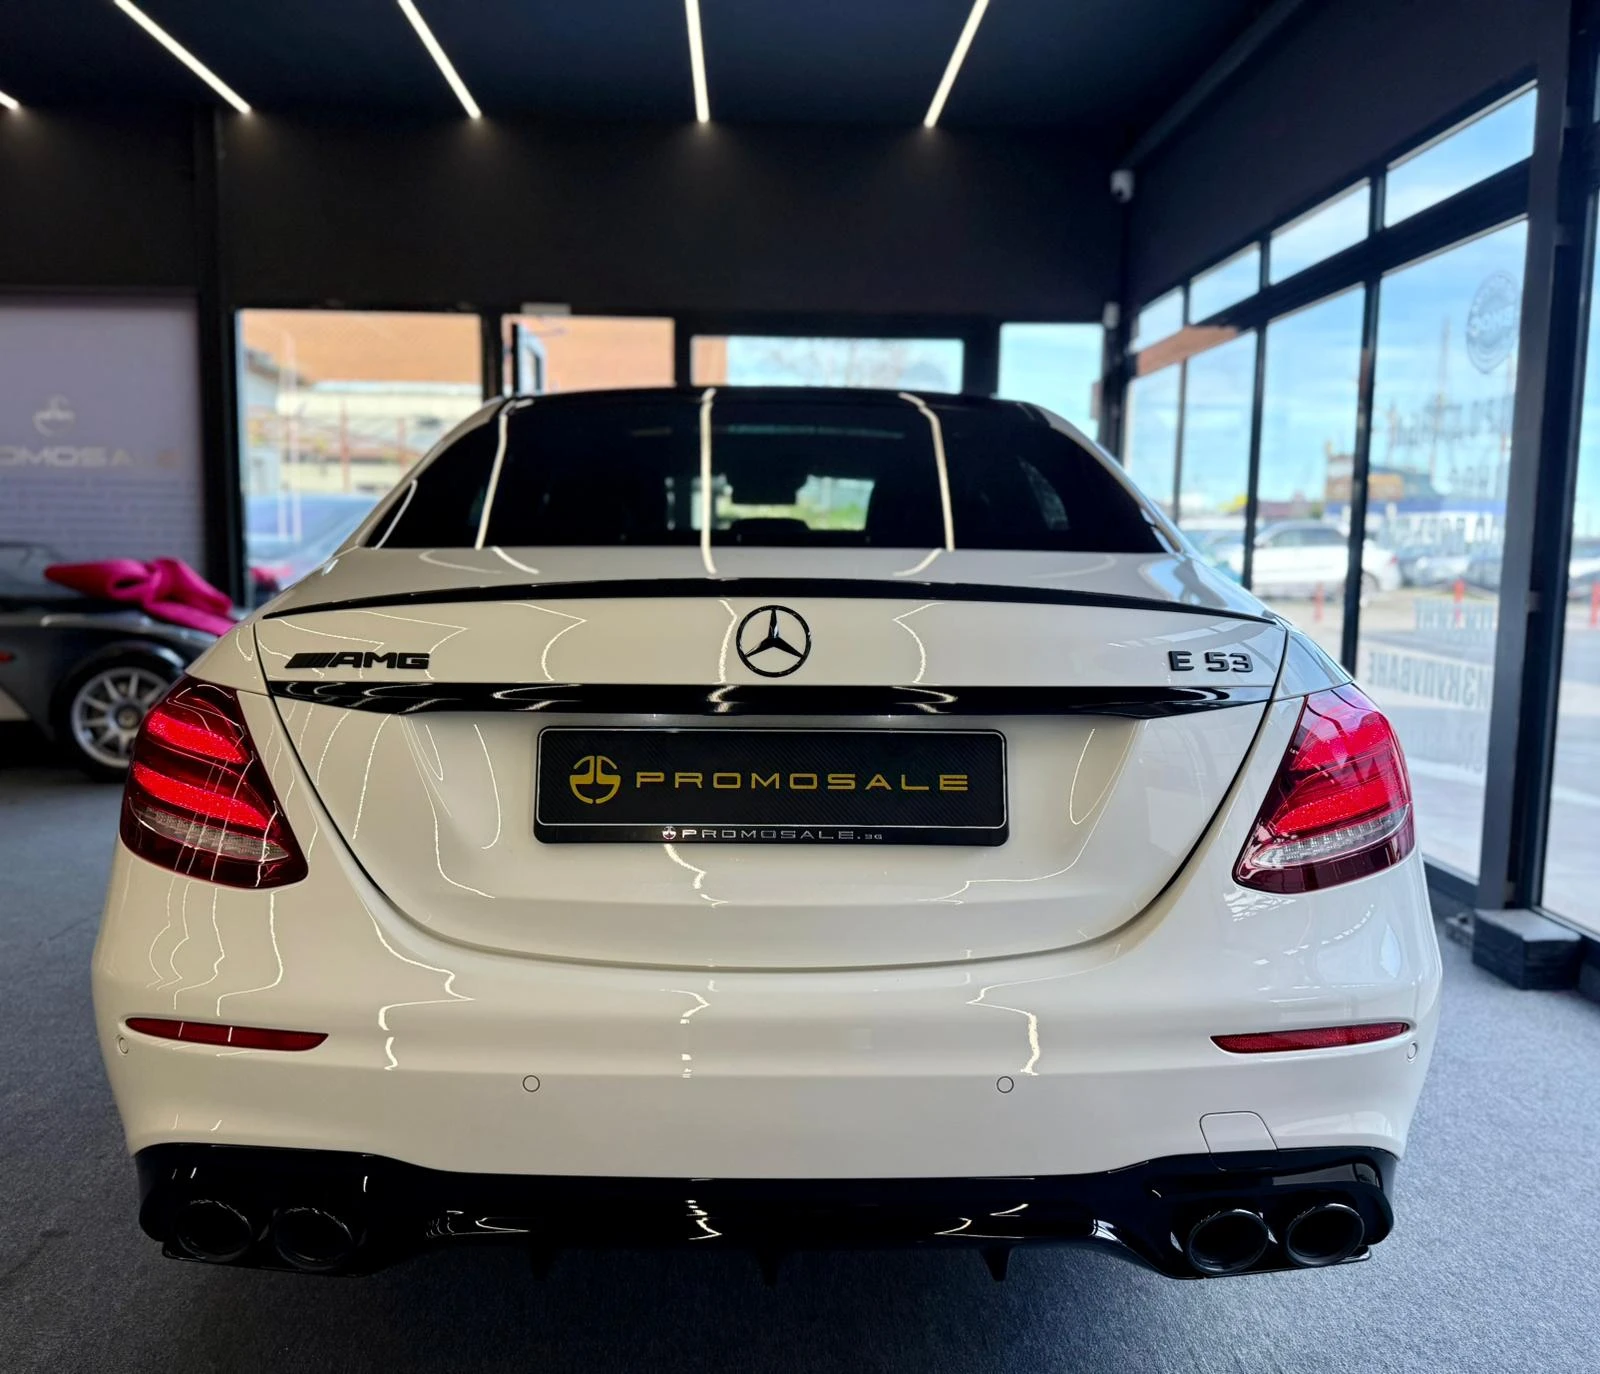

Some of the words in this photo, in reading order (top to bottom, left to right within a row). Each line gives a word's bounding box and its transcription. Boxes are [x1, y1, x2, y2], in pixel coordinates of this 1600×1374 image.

[328, 652, 430, 669] AMG
[1168, 651, 1195, 671] E
[1204, 652, 1254, 672] 53
[635, 770, 969, 791] PROMOSALE
